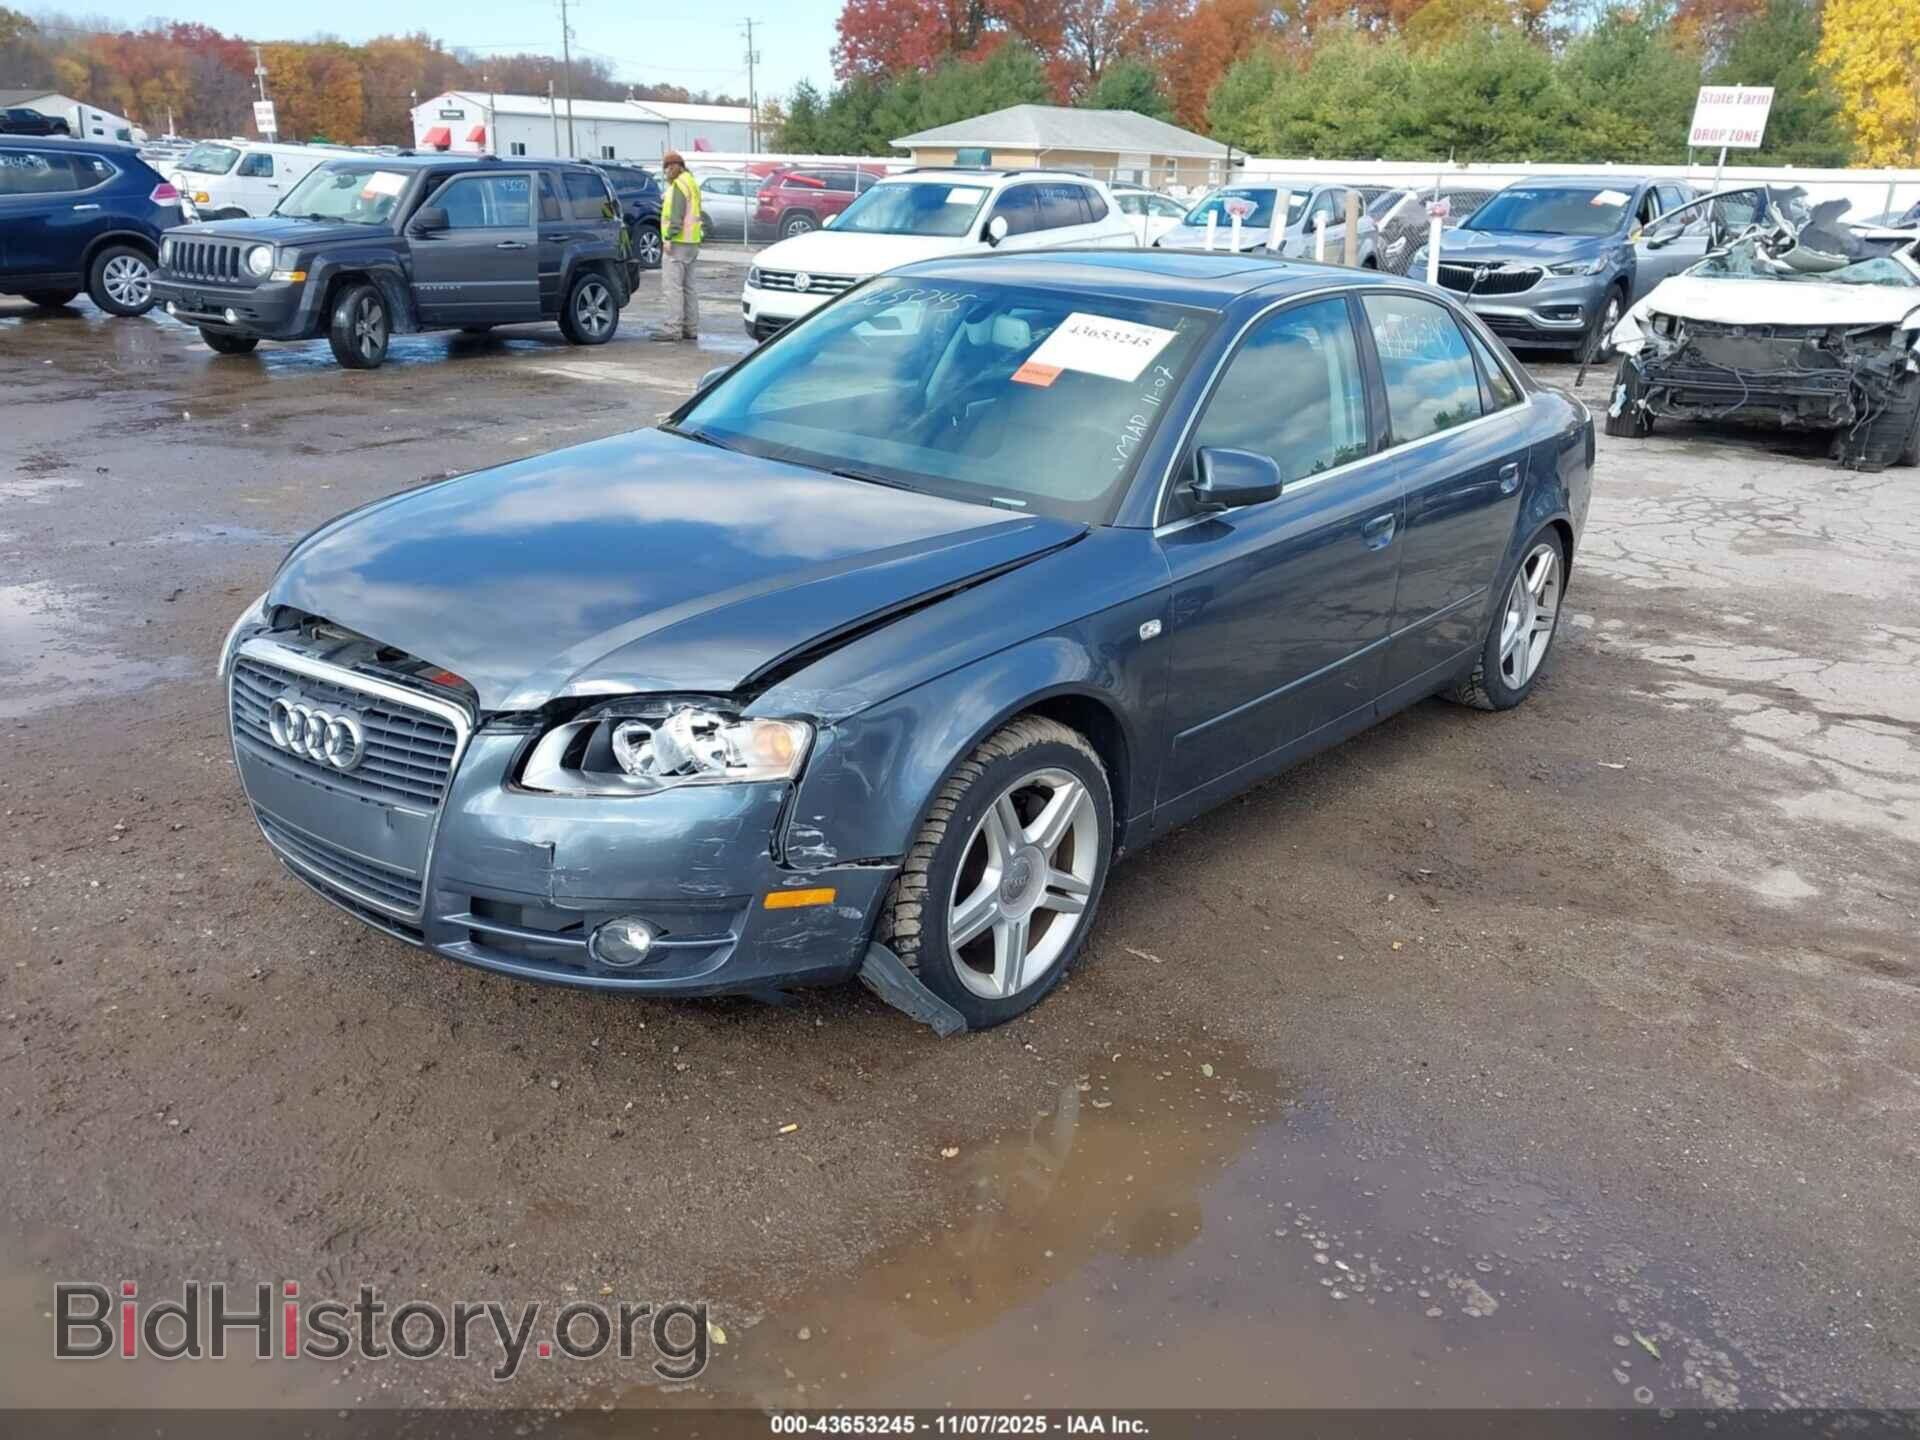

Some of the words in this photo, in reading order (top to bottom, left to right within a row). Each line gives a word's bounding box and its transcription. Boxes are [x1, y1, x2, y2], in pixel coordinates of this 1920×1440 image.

[1700, 91, 1734, 104] State
[1693, 128, 1727, 141] DROP
[1728, 129, 1761, 142] ZONE
[1069, 324, 1152, 347] 43653245
